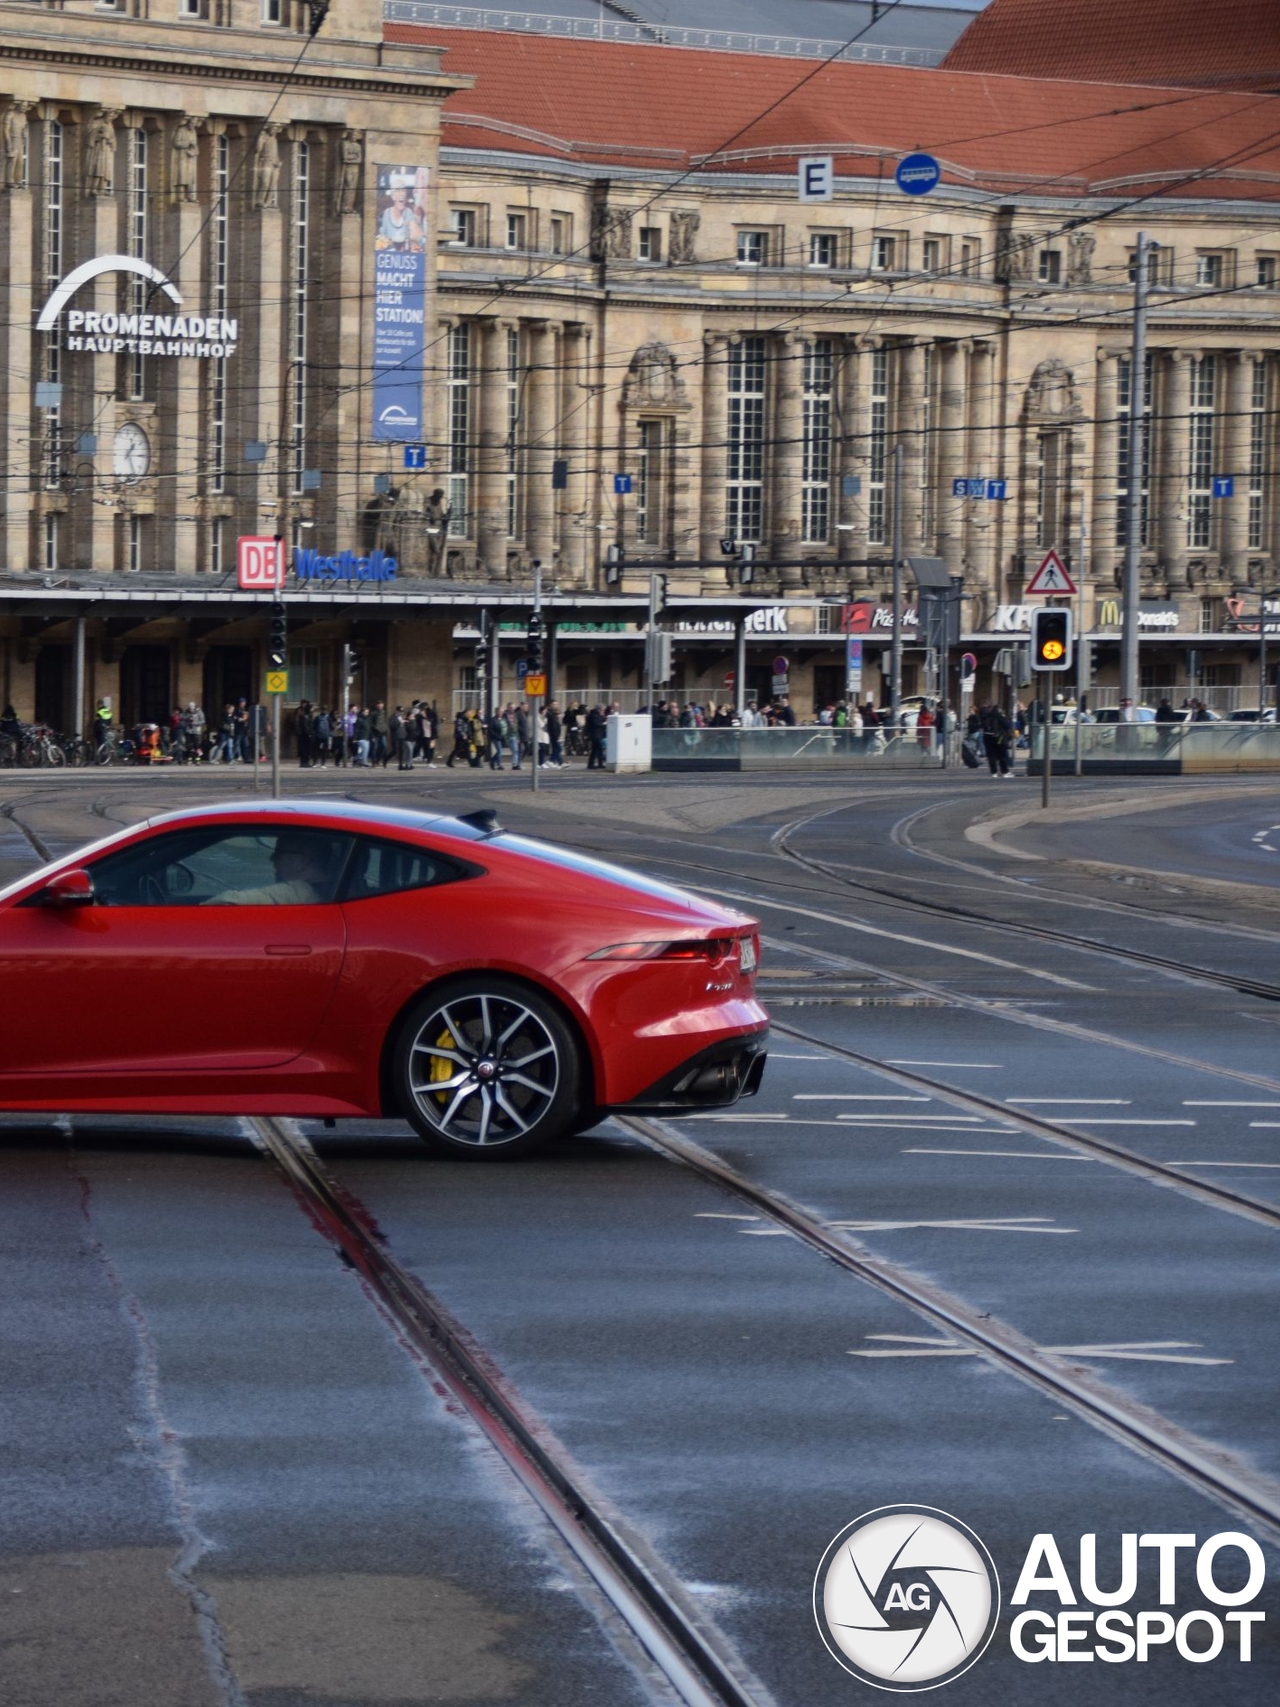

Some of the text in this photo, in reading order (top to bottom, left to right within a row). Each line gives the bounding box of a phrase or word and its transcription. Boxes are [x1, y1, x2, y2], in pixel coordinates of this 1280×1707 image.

[806, 164, 826, 195] E
[376, 254, 418, 269] GENUSS
[376, 272, 415, 288] MACHT
[376, 290, 403, 305] HIER
[376, 308, 424, 323] STATION!
[68, 310, 238, 340] PROMENADEN
[68, 336, 238, 358] HAUPTBAHNHOF
[409, 449, 421, 465] T
[616, 477, 628, 491] T
[956, 481, 966, 495] S
[991, 482, 1003, 497] T
[1217, 480, 1229, 495] T
[246, 546, 278, 579] DB
[294, 548, 399, 581] Westhalle
[993, 605, 1033, 631] KF
[519, 661, 527, 672] P
